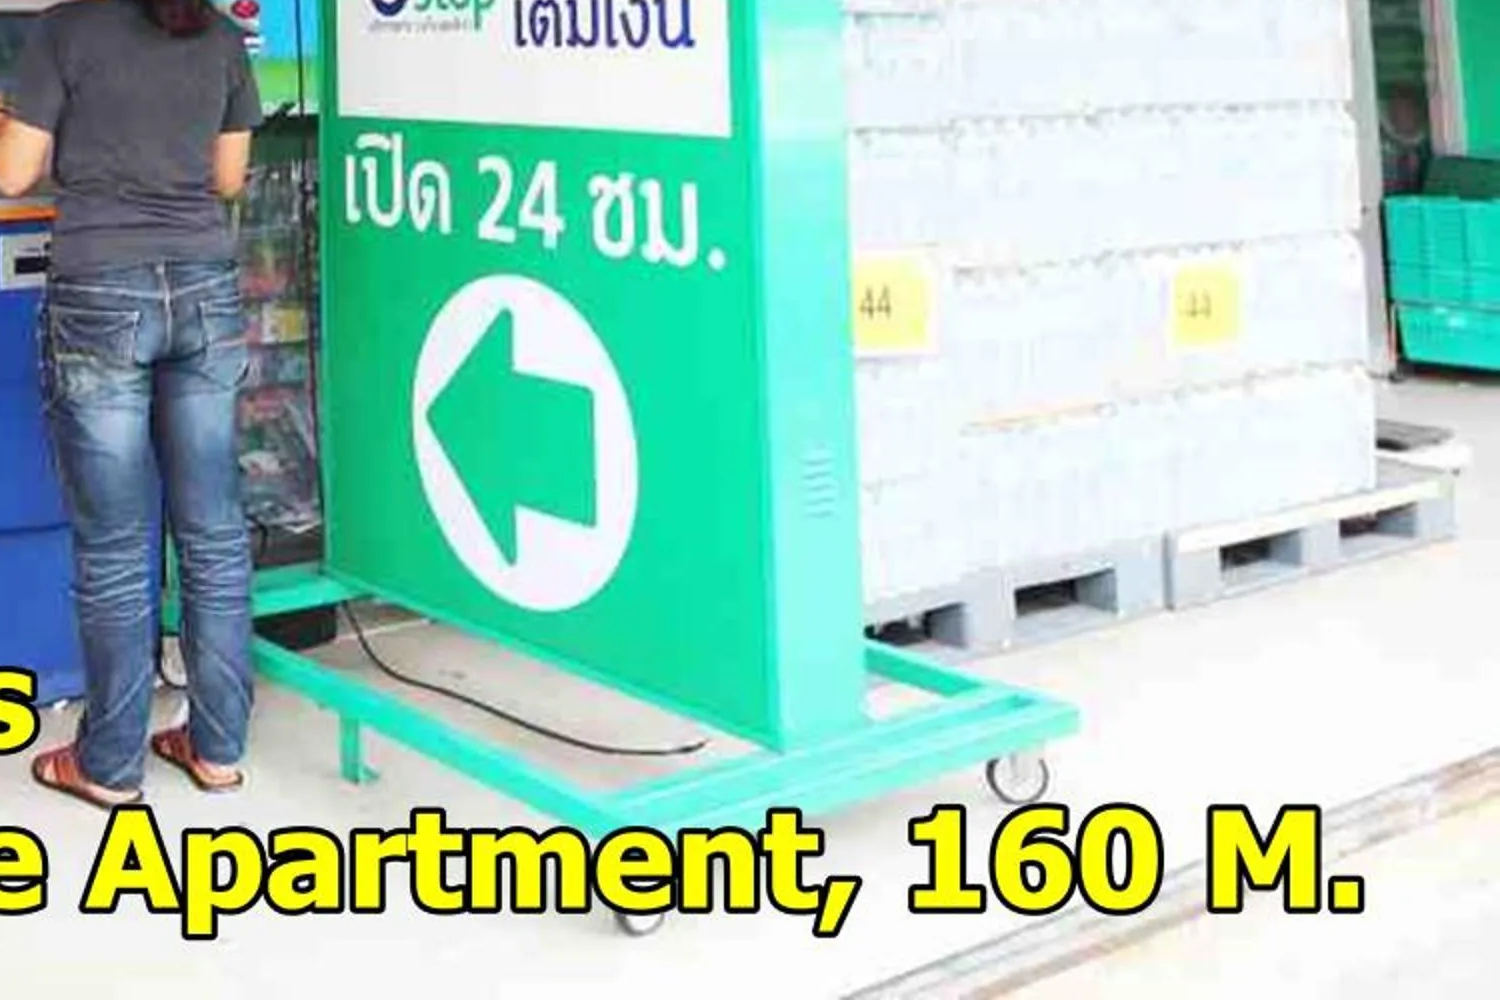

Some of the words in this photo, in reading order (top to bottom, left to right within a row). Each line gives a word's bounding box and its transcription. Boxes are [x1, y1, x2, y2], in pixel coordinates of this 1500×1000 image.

[343, 130, 453, 237] เปิด
[476, 154, 567, 251] 24
[588, 168, 727, 271] ชม.
[858, 285, 893, 320] 44
